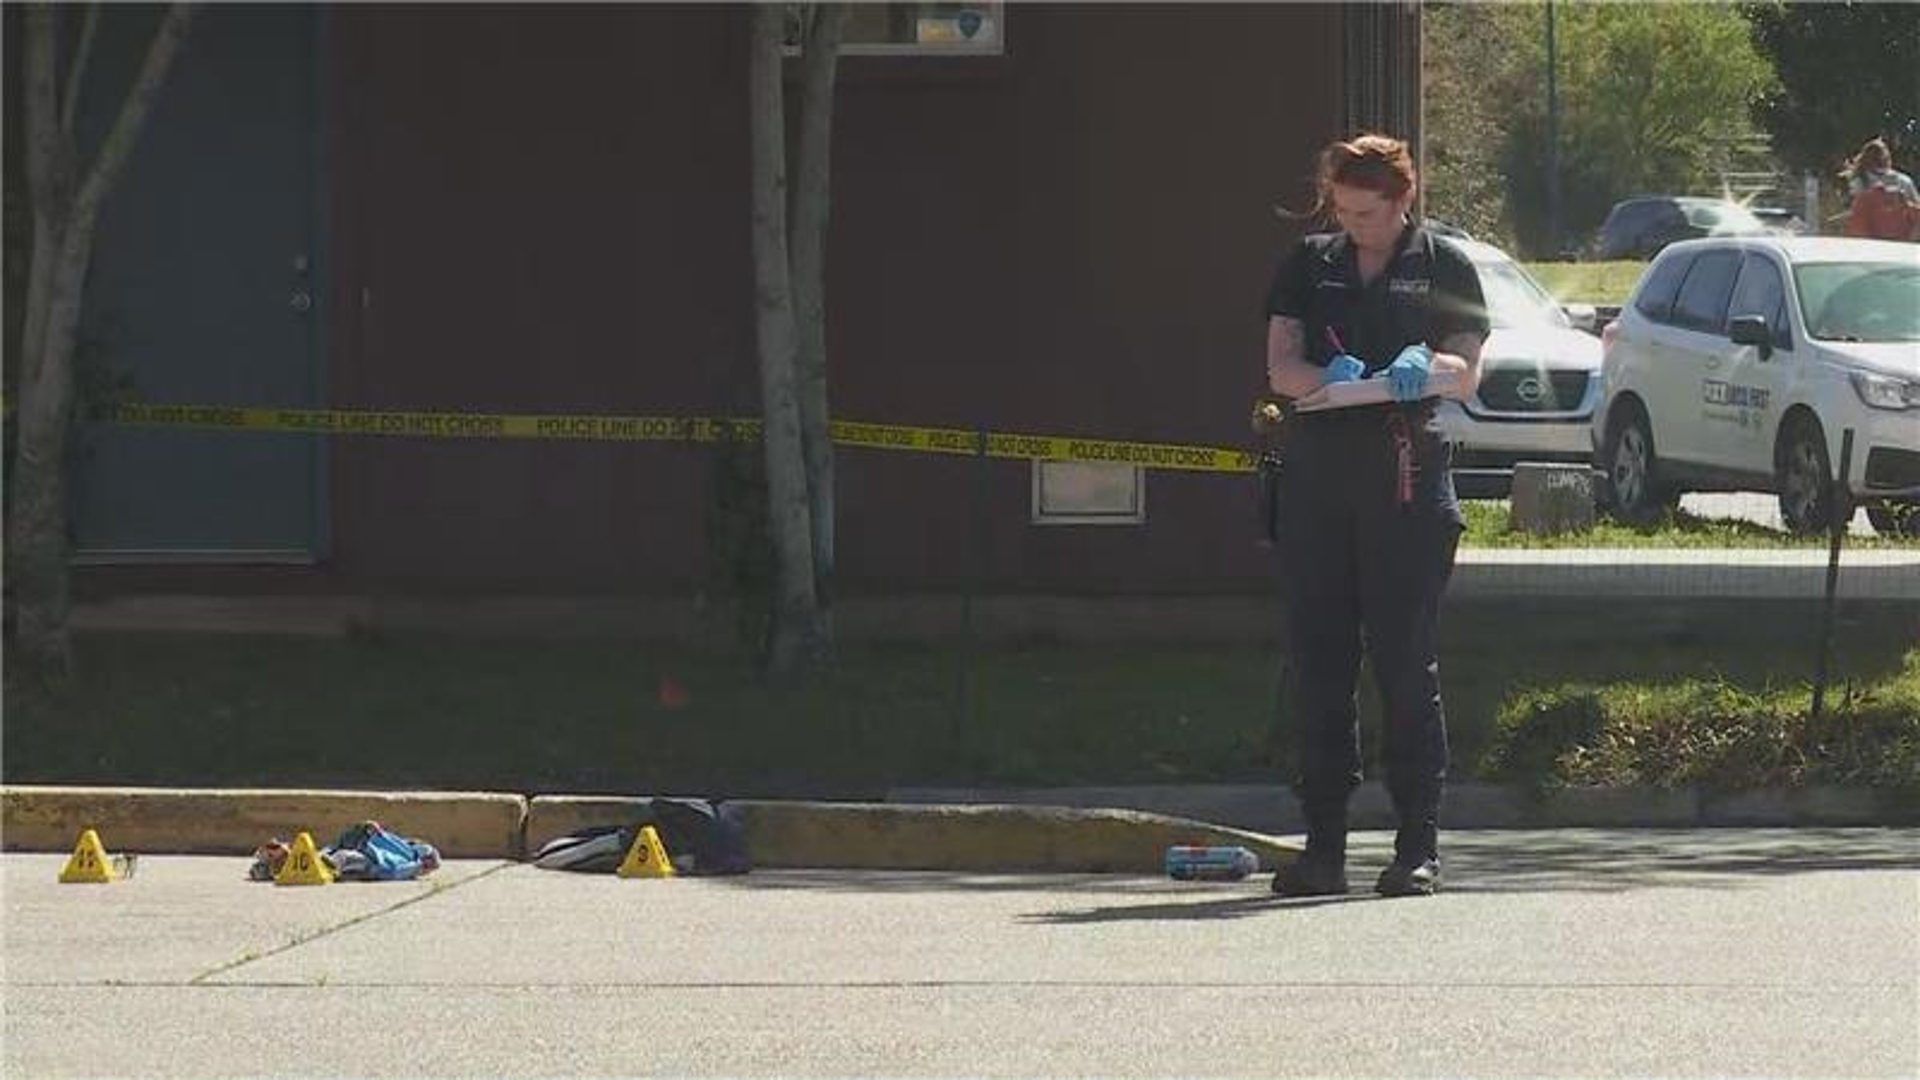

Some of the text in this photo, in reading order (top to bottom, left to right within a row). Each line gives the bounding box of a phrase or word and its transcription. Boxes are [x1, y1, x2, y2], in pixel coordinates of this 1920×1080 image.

[537, 418, 598, 436] POLICE
[602, 420, 636, 437] LINE
[642, 420, 668, 437] DO
[1069, 441, 1107, 460] POLICE
[1108, 443, 1131, 461] LINE
[1133, 445, 1149, 462] DO
[1151, 447, 1174, 464] NOT
[1175, 448, 1216, 467] CROSS
[293, 852, 309, 871] 10
[637, 844, 650, 863] 9
